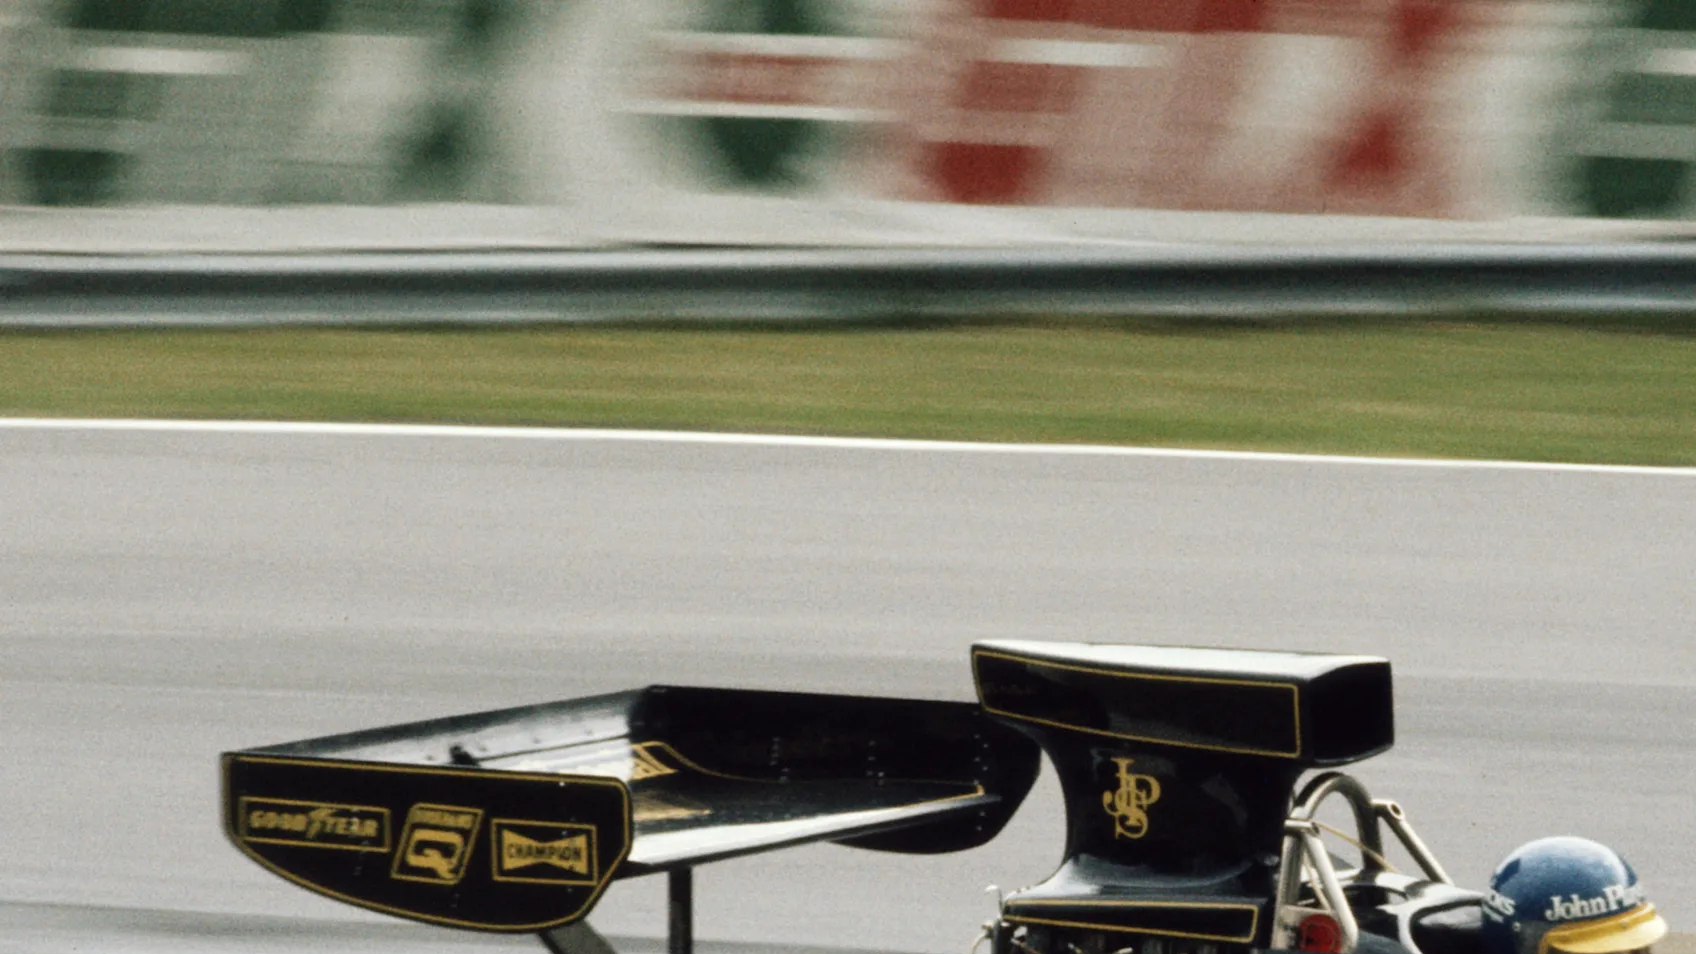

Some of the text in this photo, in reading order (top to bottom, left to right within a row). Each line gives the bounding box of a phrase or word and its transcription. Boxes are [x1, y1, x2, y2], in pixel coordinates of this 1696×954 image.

[406, 828, 465, 880] Q
[507, 843, 582, 862] CHAMPION
[1545, 895, 1607, 921] John
